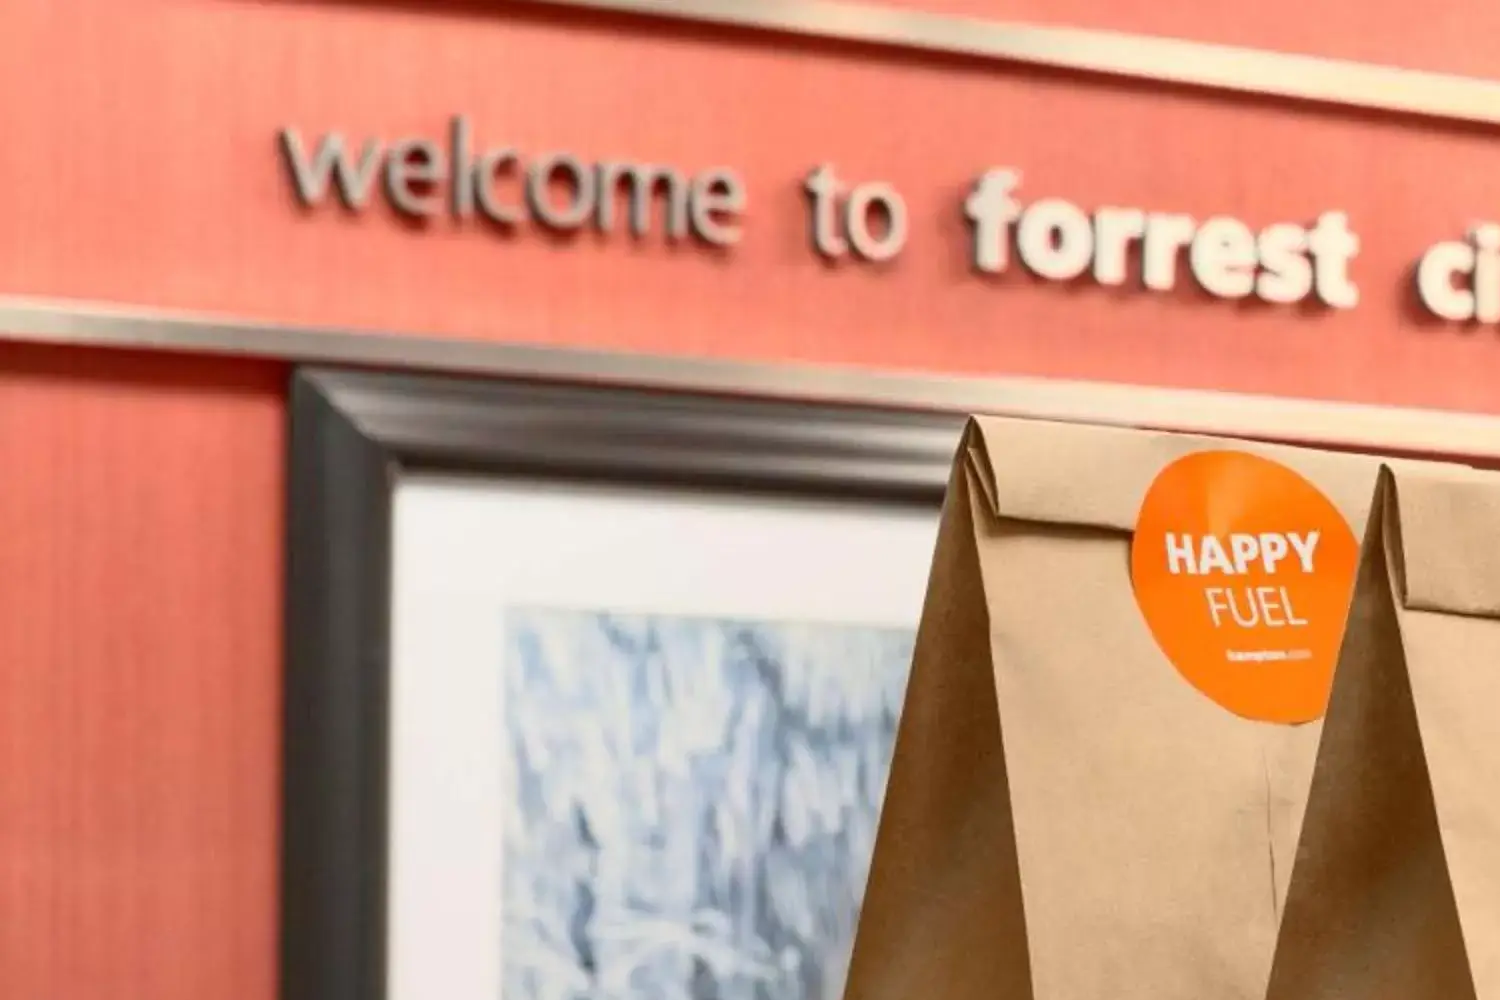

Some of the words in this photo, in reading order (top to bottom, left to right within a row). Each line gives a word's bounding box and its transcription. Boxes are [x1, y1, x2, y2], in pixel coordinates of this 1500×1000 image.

[278, 115, 746, 246] welcome
[804, 163, 907, 262] to
[965, 168, 1360, 308] forrest
[1165, 531, 1320, 575] HAPPY
[1204, 586, 1309, 628] FUEL
